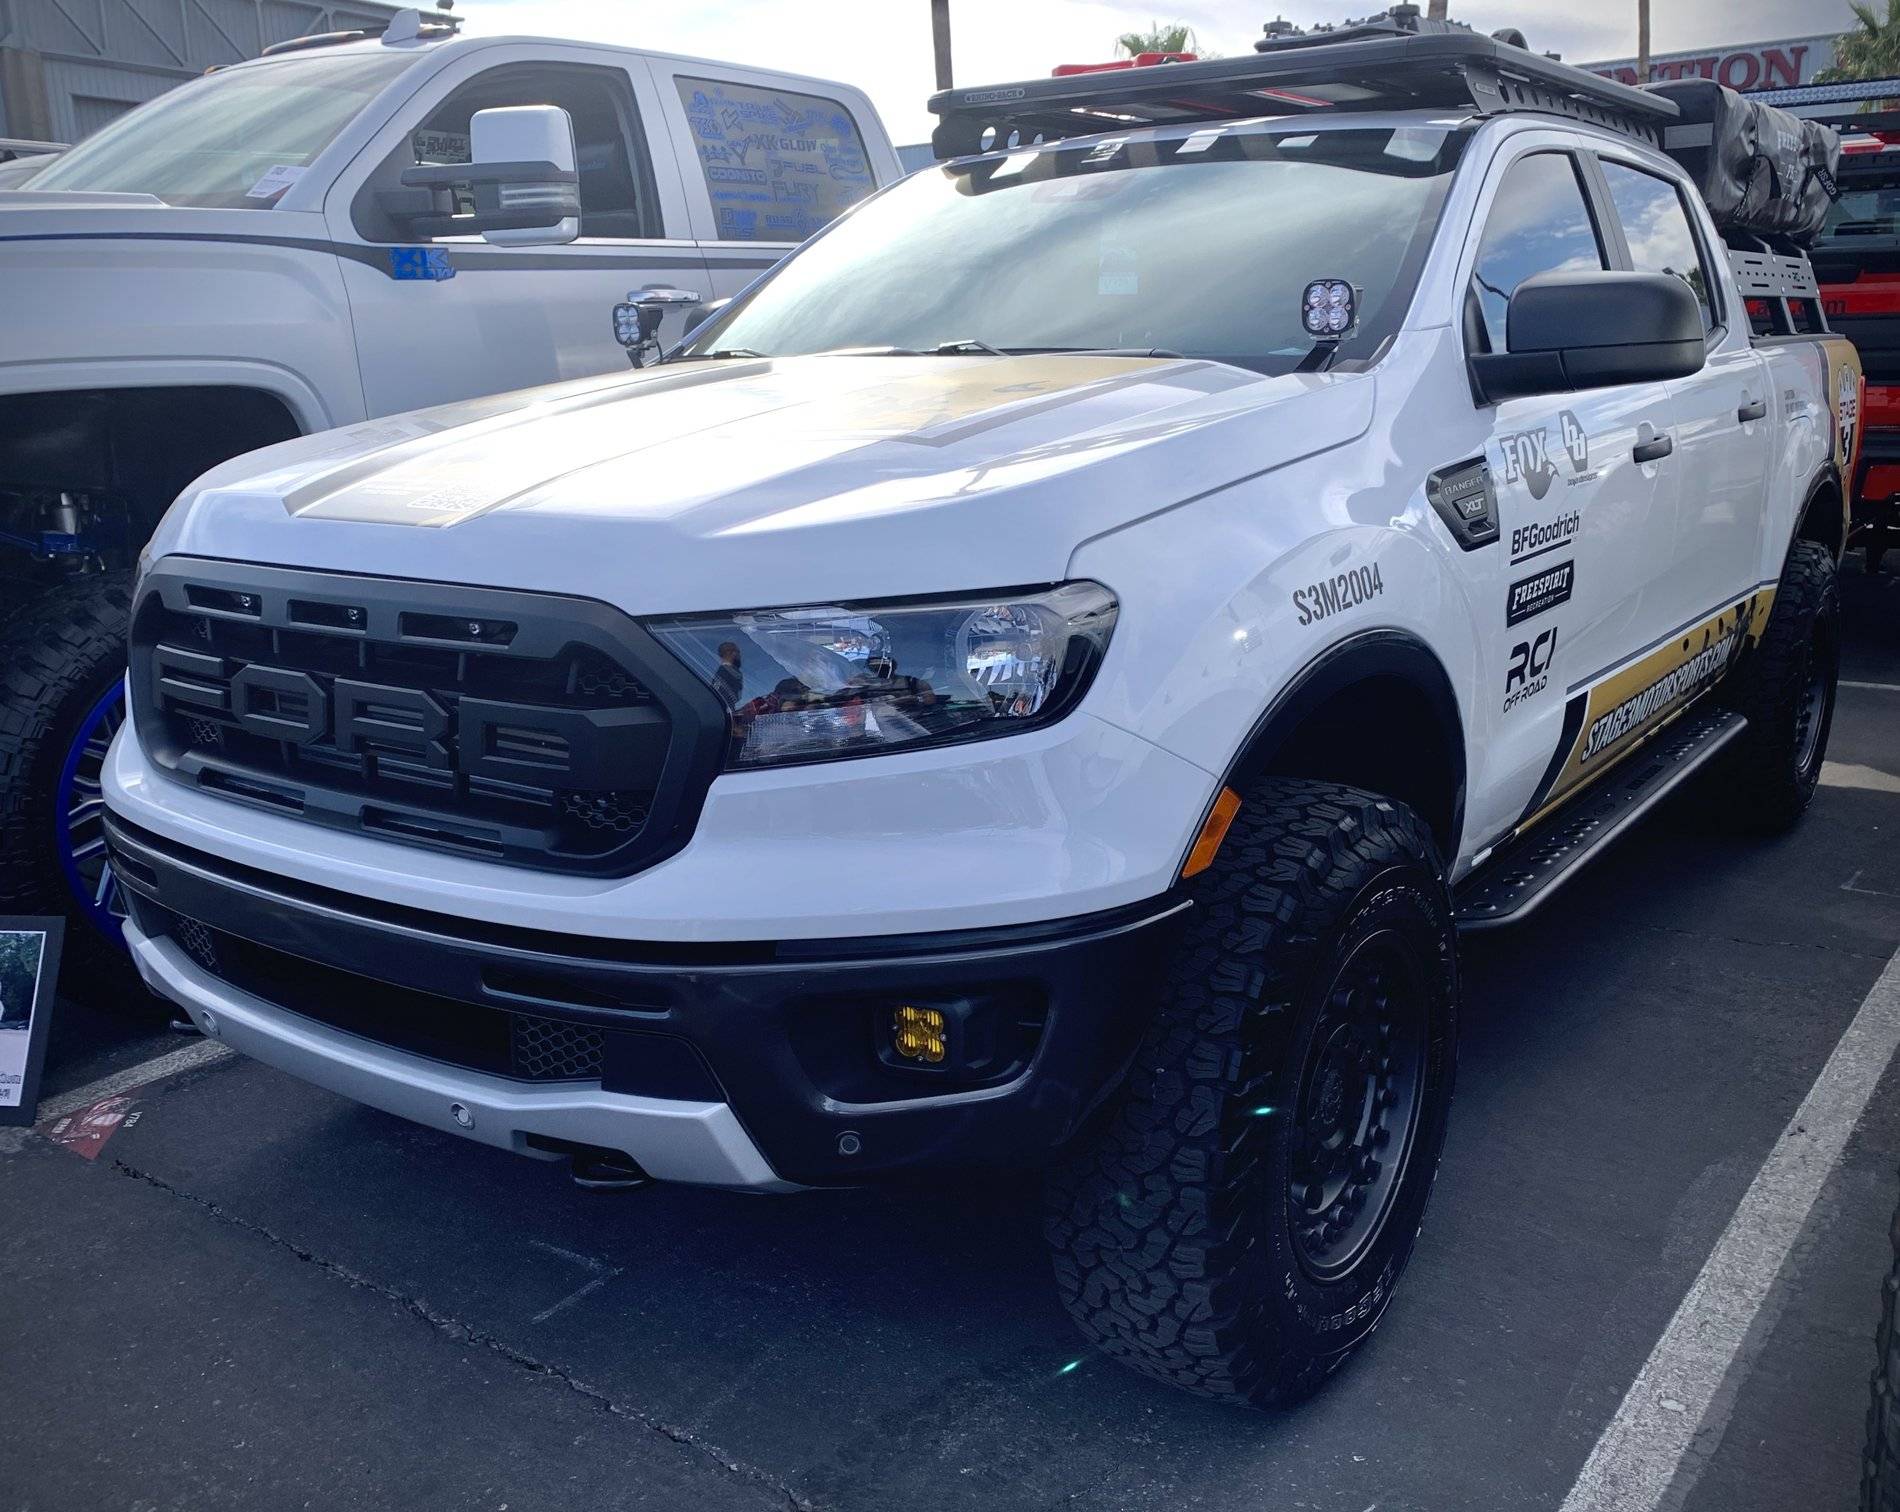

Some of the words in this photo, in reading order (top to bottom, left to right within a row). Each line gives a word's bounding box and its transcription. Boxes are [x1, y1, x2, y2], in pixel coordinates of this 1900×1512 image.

[1592, 46, 1808, 94] TION
[1499, 427, 1548, 485] FOX
[1444, 476, 1483, 496] RANGER
[1464, 497, 1484, 514] XLT
[1511, 510, 1580, 555] BFGoodrich
[1292, 562, 1383, 626] S3M2004
[1511, 566, 1571, 611] FREESPIRIT
[1505, 626, 1558, 694] RCI
[152, 643, 610, 792] FORD
